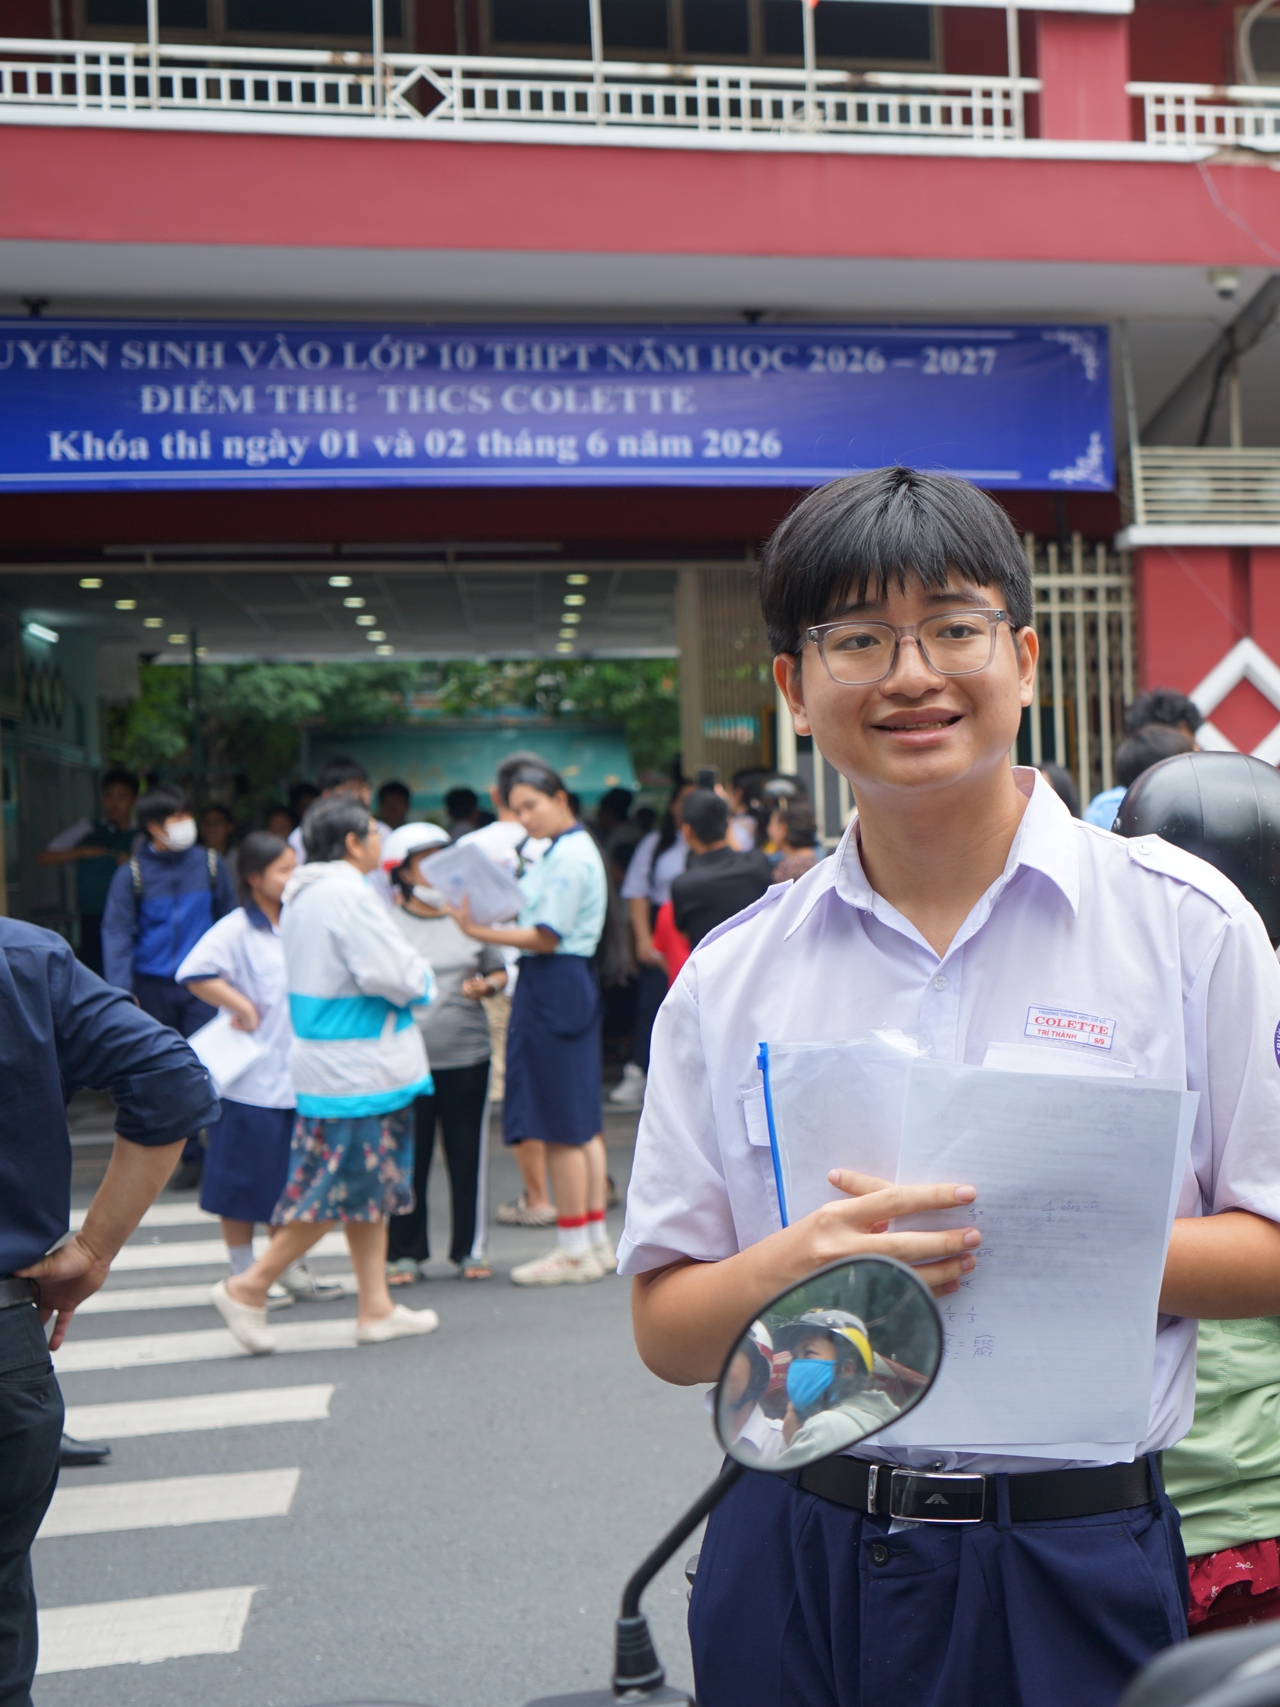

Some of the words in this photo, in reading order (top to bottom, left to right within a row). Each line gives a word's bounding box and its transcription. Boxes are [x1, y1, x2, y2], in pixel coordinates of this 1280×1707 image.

[121, 341, 225, 370] SINH
[237, 334, 332, 370] VÀO
[343, 334, 427, 370] LỚP
[440, 343, 478, 371] 10
[485, 342, 596, 371] THPT
[607, 338, 699, 371] NĂM
[711, 345, 798, 379] HỌC
[807, 346, 886, 374] 2026
[921, 346, 996, 375] 2027
[141, 378, 255, 414] ĐIỂM
[266, 384, 358, 414] THI:
[377, 384, 492, 414] THCS
[501, 384, 696, 415] COLETTE
[48, 429, 150, 461] Khóa
[160, 429, 212, 460] thi
[222, 428, 311, 467] ngày
[319, 428, 359, 460] 01
[372, 427, 416, 459] và
[424, 428, 467, 459] 02
[477, 427, 580, 466] tháng
[586, 428, 610, 459] 6
[617, 428, 693, 459] năm
[701, 428, 782, 460] 2026
[1034, 1016, 1109, 1036] COLETTE
[1037, 1028, 1051, 1036] TRÍ
[1051, 1030, 1077, 1040] THÀNH
[1093, 1037, 1105, 1045] 9/9
